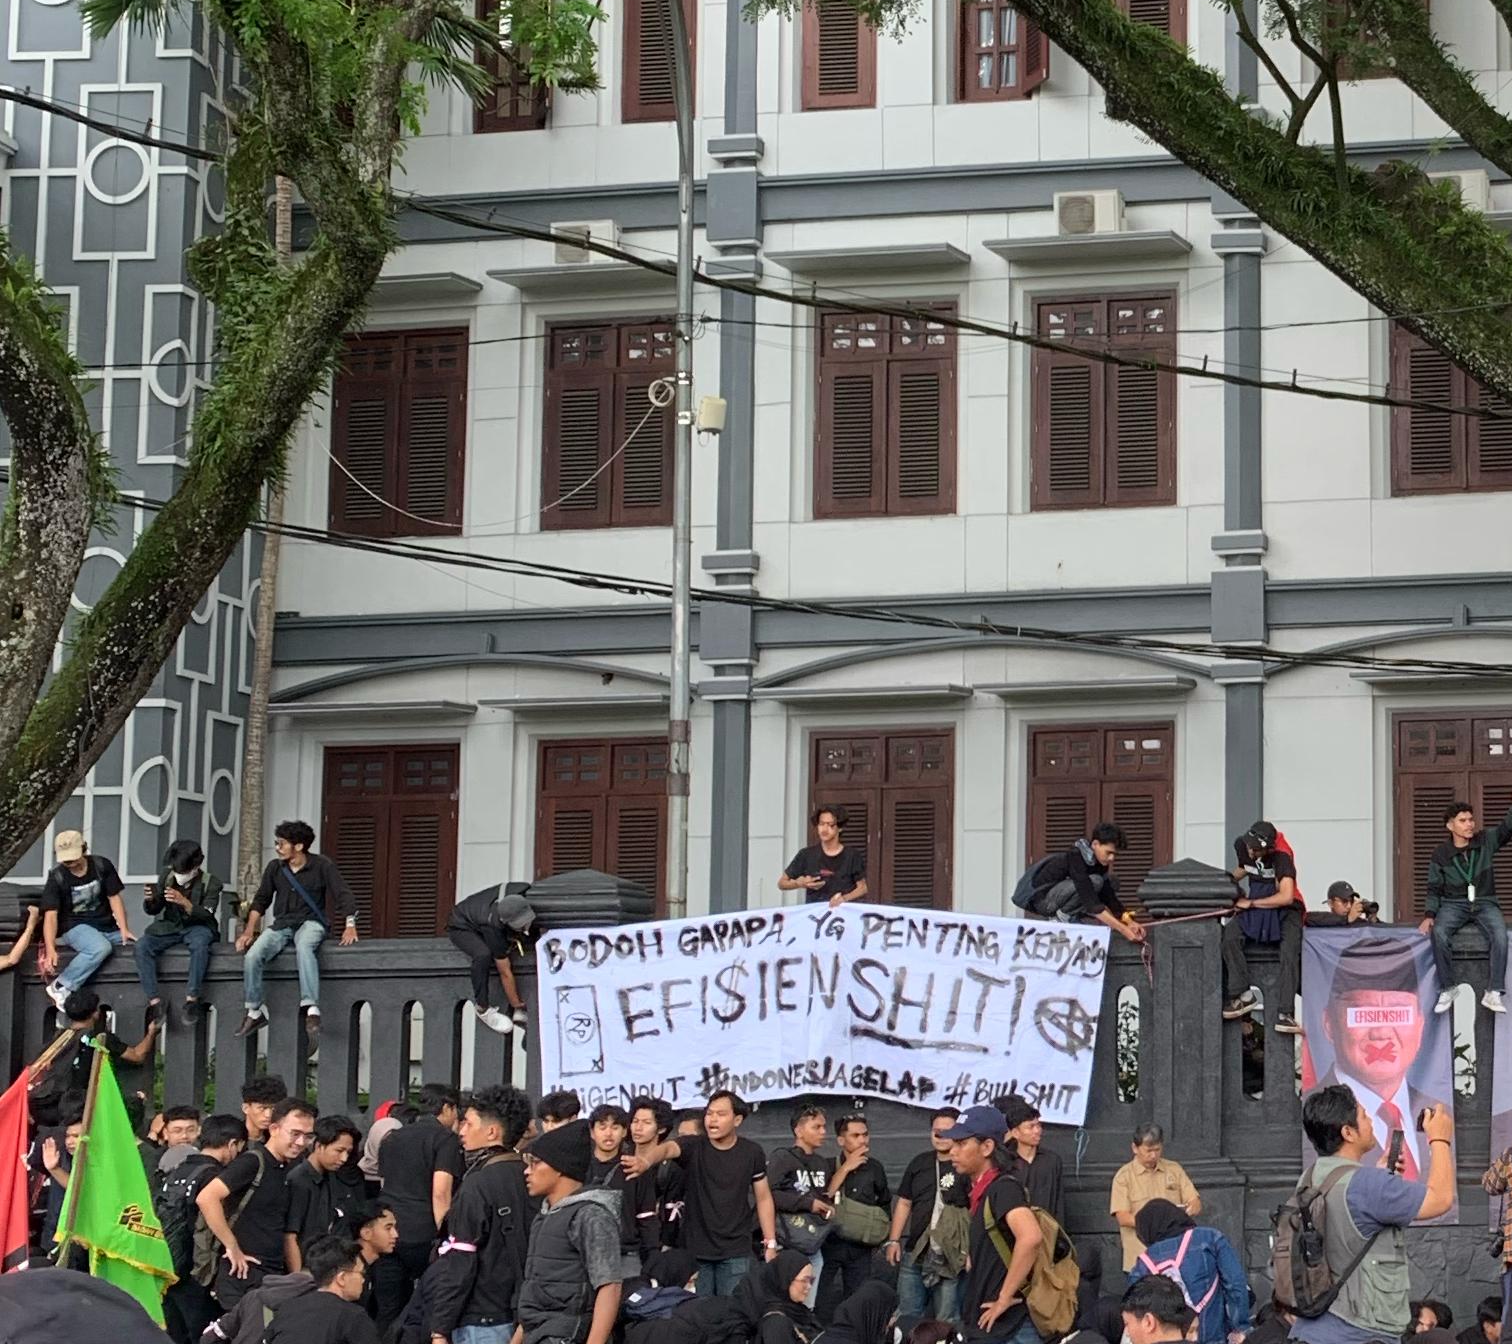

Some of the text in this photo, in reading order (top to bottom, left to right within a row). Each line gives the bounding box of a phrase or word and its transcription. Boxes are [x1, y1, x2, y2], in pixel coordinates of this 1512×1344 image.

[544, 929, 664, 974] BODOH
[807, 910, 846, 941] YG
[860, 912, 1001, 963] PENTING
[796, 1169, 825, 1187] VANS
